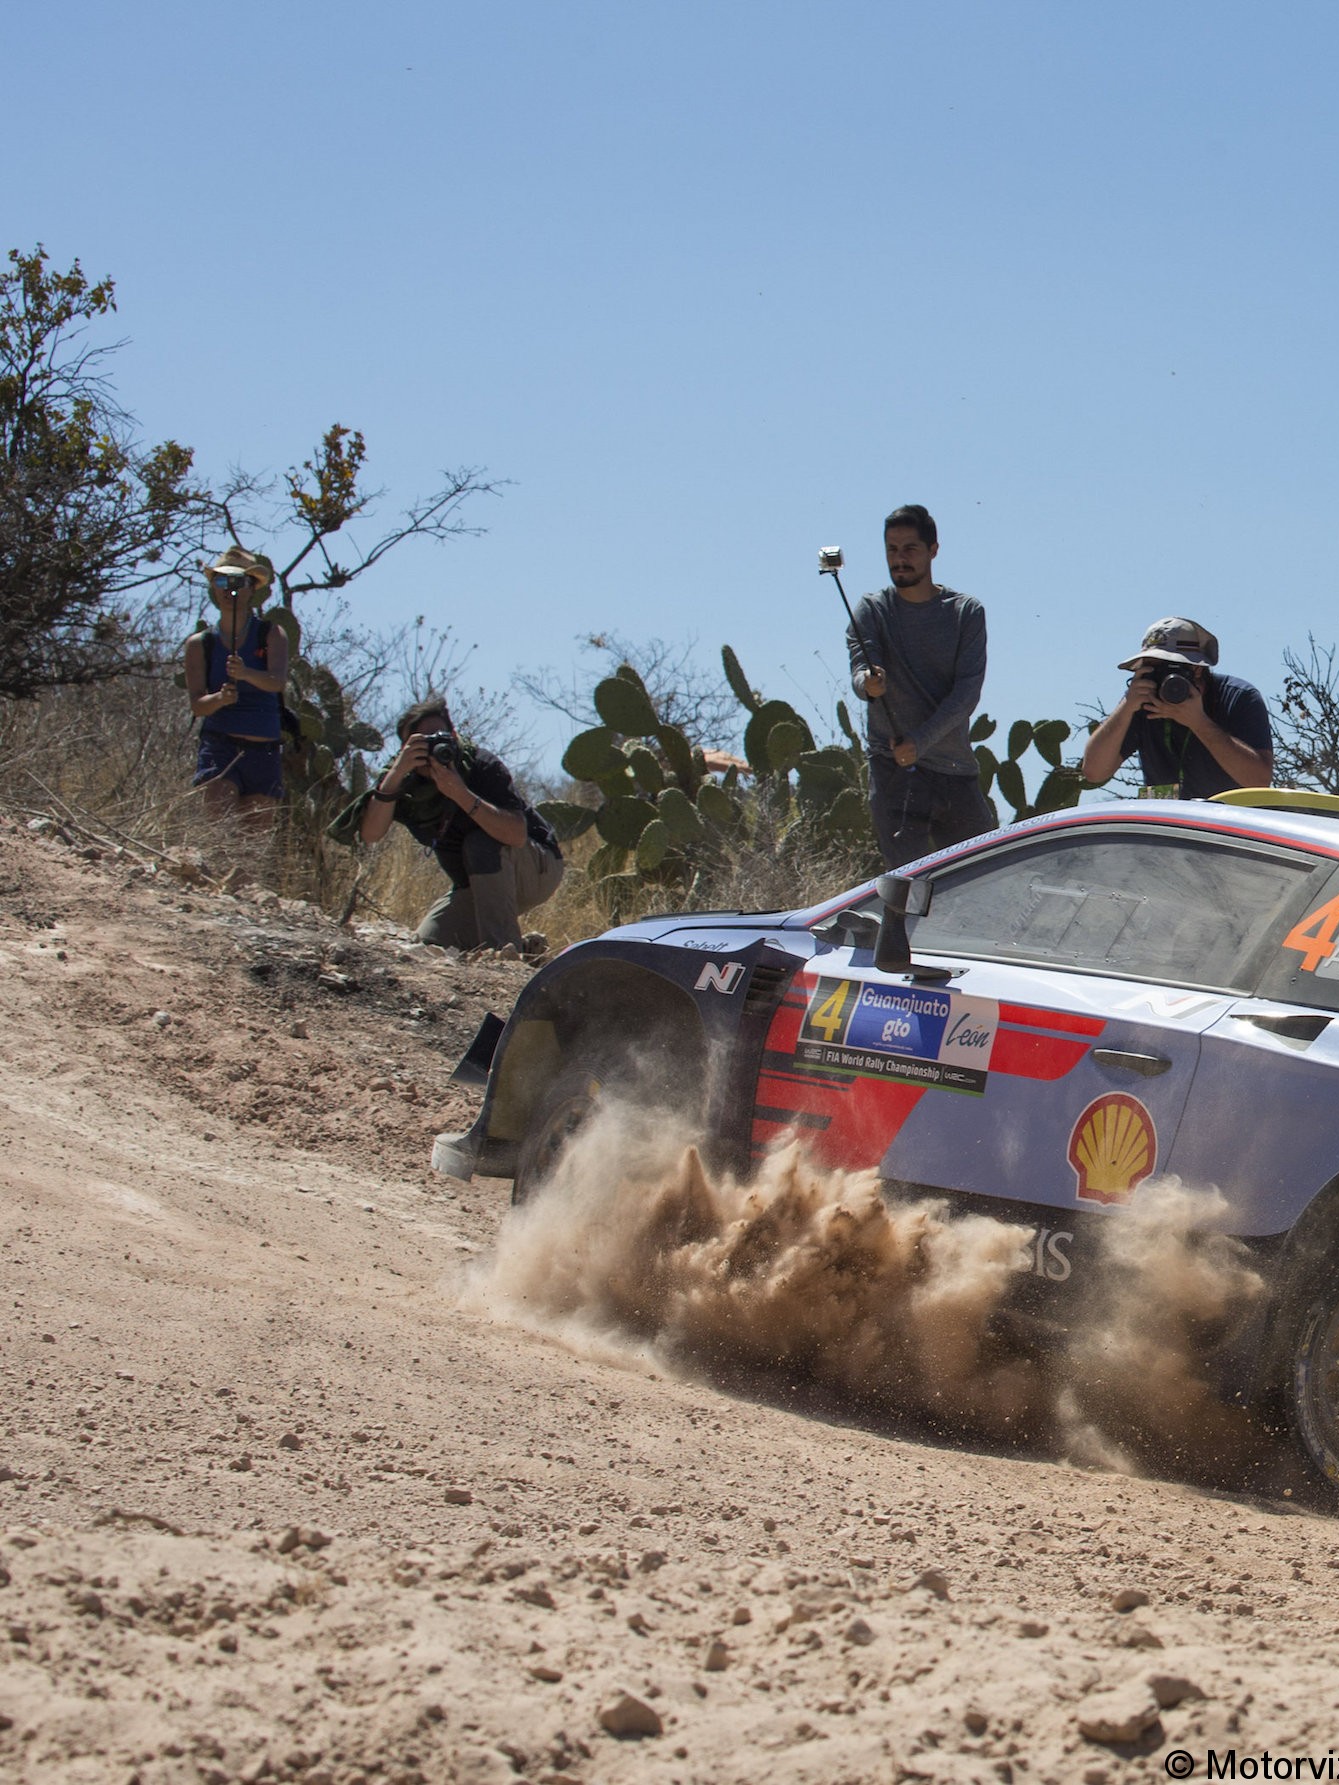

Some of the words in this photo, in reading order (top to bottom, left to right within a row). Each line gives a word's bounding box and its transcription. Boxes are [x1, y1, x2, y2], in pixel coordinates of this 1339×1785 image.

[810, 980, 850, 1041] 4
[861, 987, 949, 1018] Guanajuato
[881, 1018, 911, 1042] gto
[945, 1013, 991, 1049] León
[826, 1050, 840, 1063] FIA
[841, 1053, 864, 1067] World
[865, 1056, 885, 1072] Rally
[886, 1060, 941, 1081] Championship
